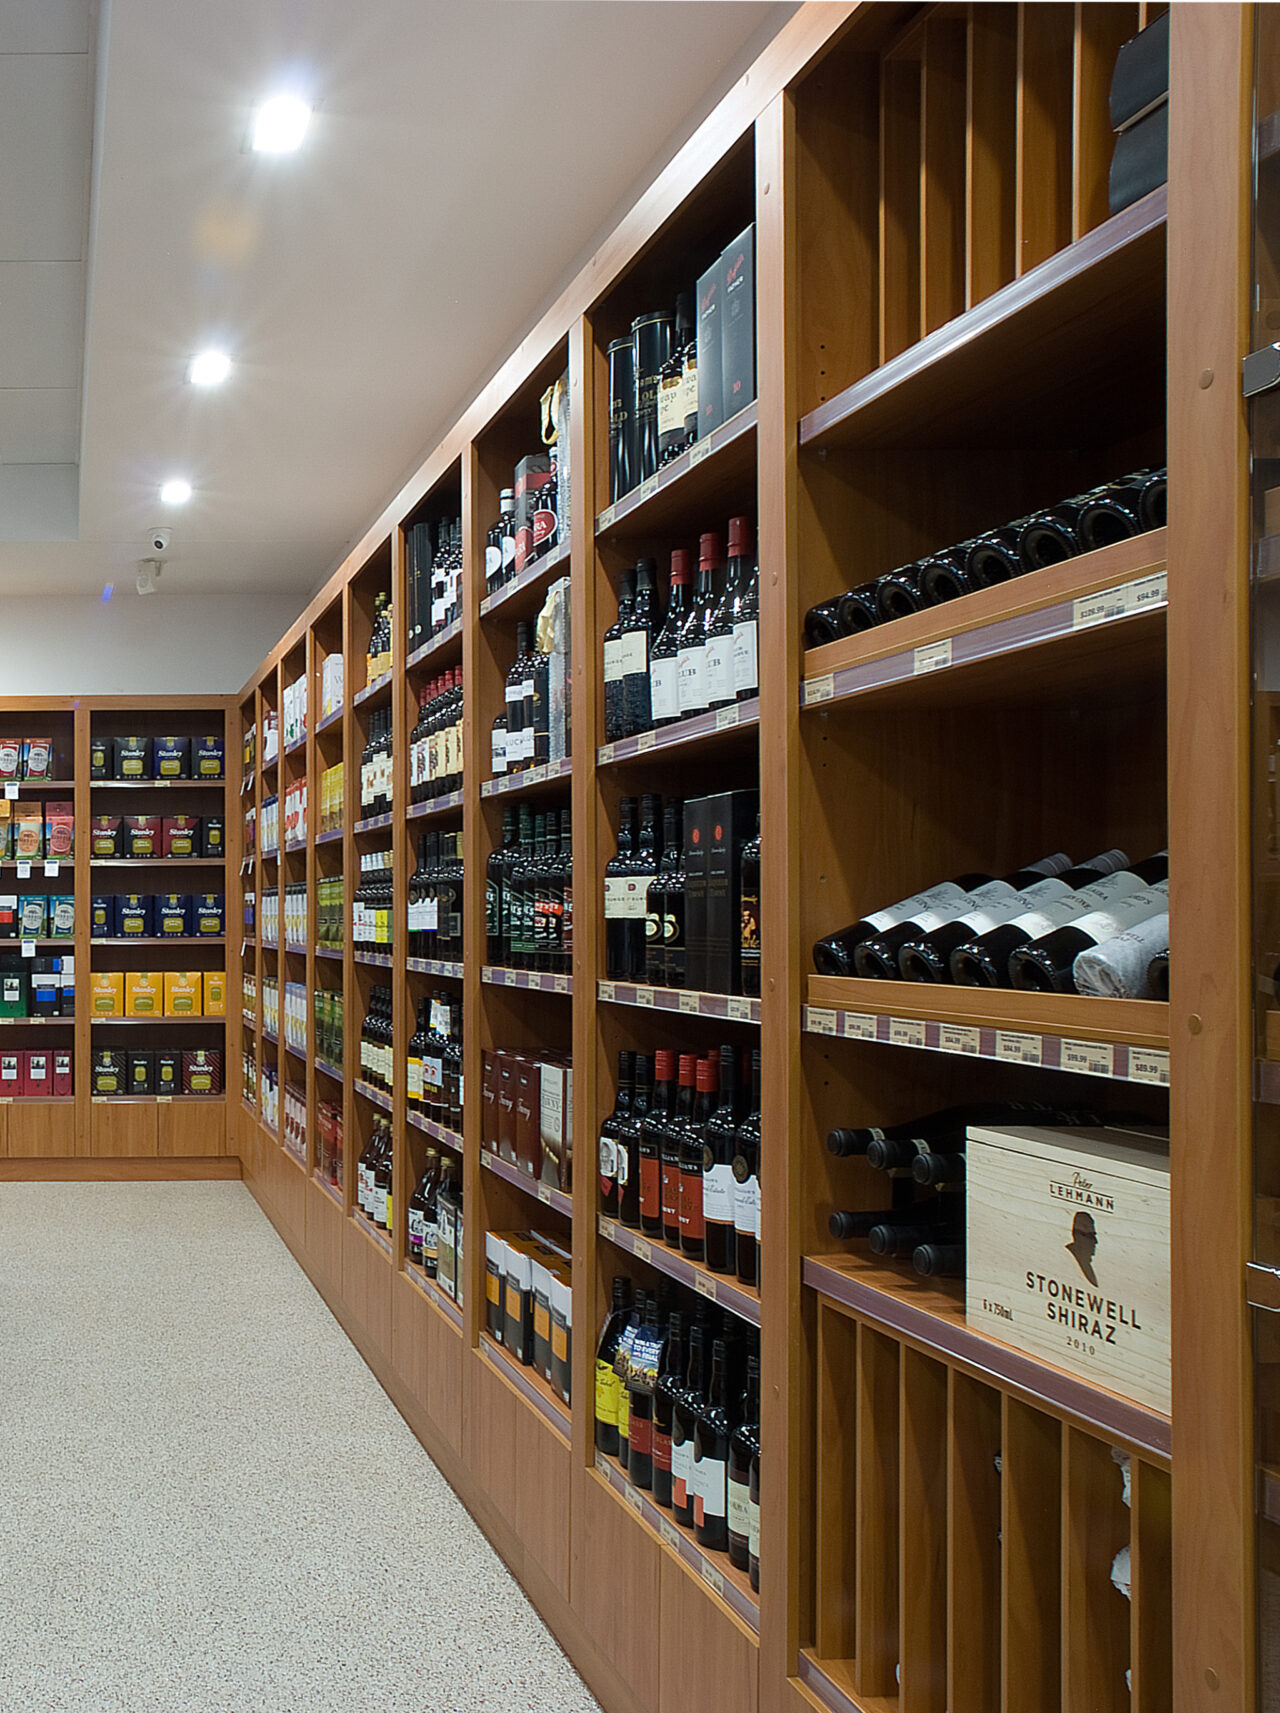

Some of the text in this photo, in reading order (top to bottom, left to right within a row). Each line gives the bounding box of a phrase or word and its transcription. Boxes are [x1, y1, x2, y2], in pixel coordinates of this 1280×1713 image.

[120, 750, 145, 758] Stanley
[158, 750, 183, 758] Stanley
[92, 829, 117, 837] Stanley
[130, 829, 155, 837] Stanley
[168, 829, 194, 837] Stanley
[121, 907, 146, 916] Stanley
[161, 907, 186, 916] Stanley
[197, 907, 223, 916] Stanley
[1072, 1171, 1093, 1189] Peter
[1049, 1184, 1115, 1211] LEHMANN
[1026, 1271, 1142, 1331] STONEWELL
[983, 1299, 988, 1310] 6
[993, 1302, 1014, 1322] 750mL
[1047, 1302, 1116, 1345] SHIRAZ
[1066, 1336, 1096, 1356] 2010
